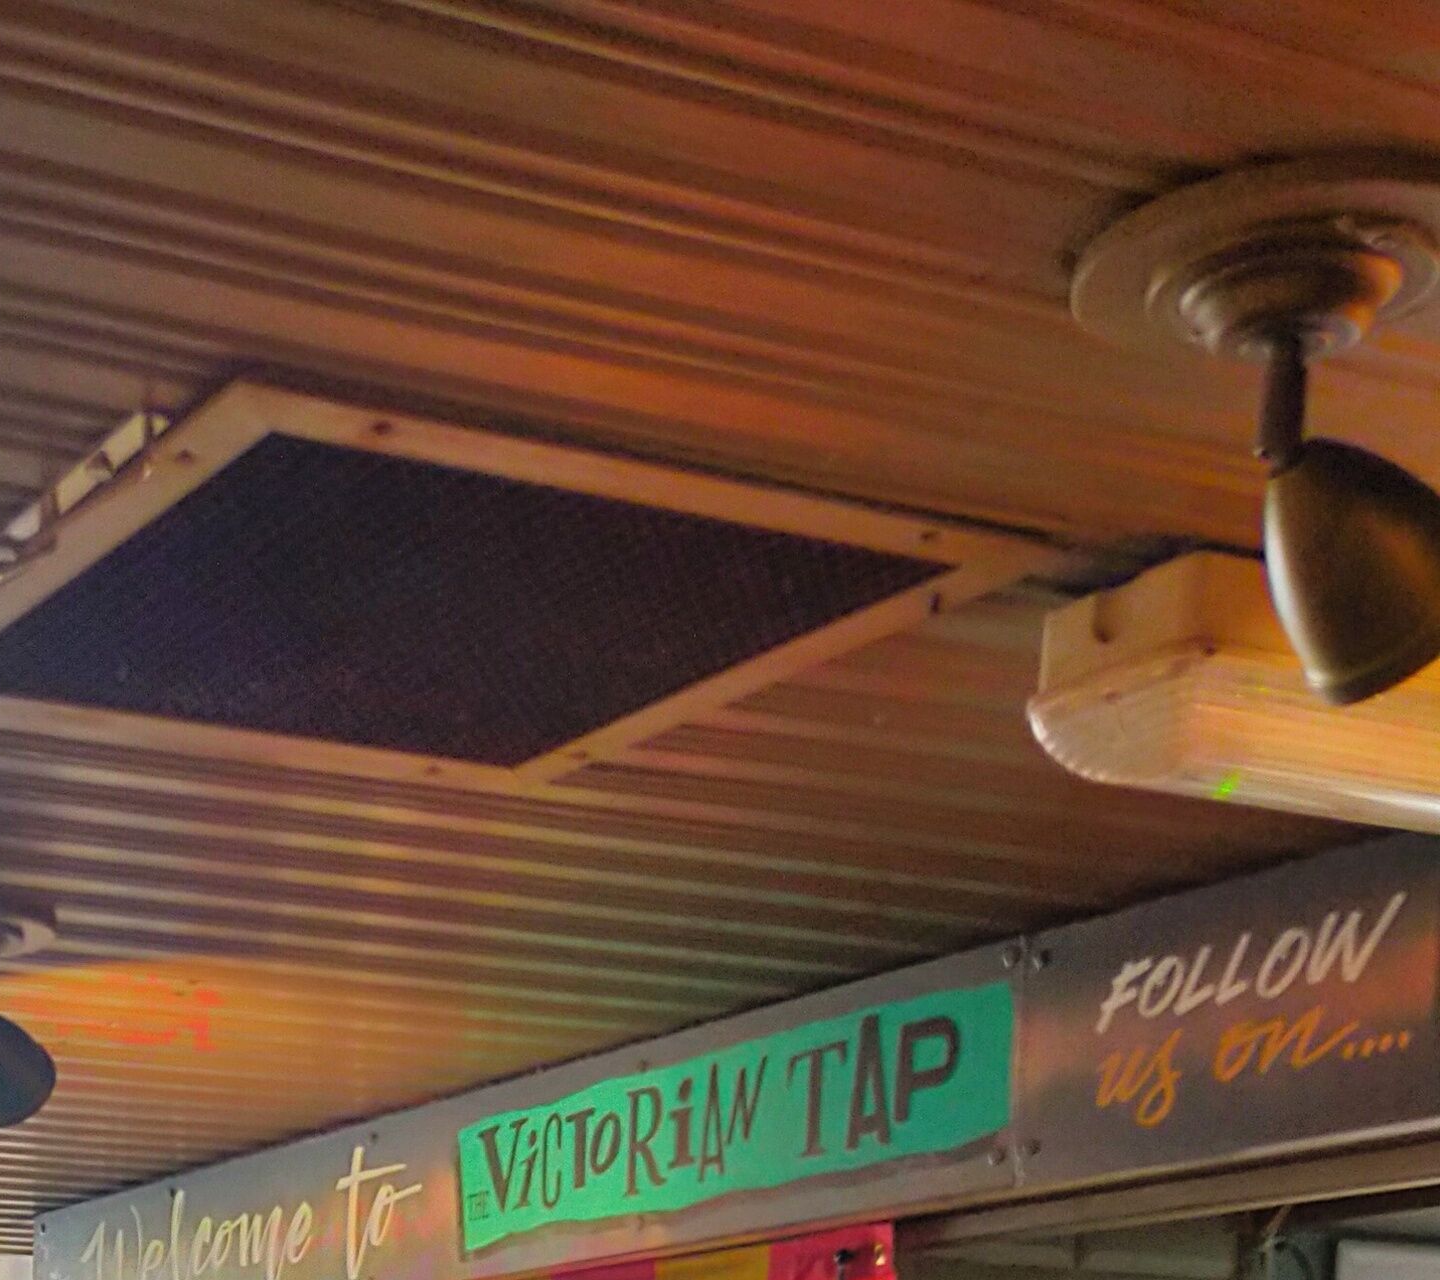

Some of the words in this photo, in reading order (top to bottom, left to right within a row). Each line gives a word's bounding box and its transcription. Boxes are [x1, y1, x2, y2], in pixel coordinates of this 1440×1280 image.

[1096, 891, 1408, 1035] FOLLOW
[788, 1012, 960, 1160] TAP
[336, 1146, 422, 1280] to
